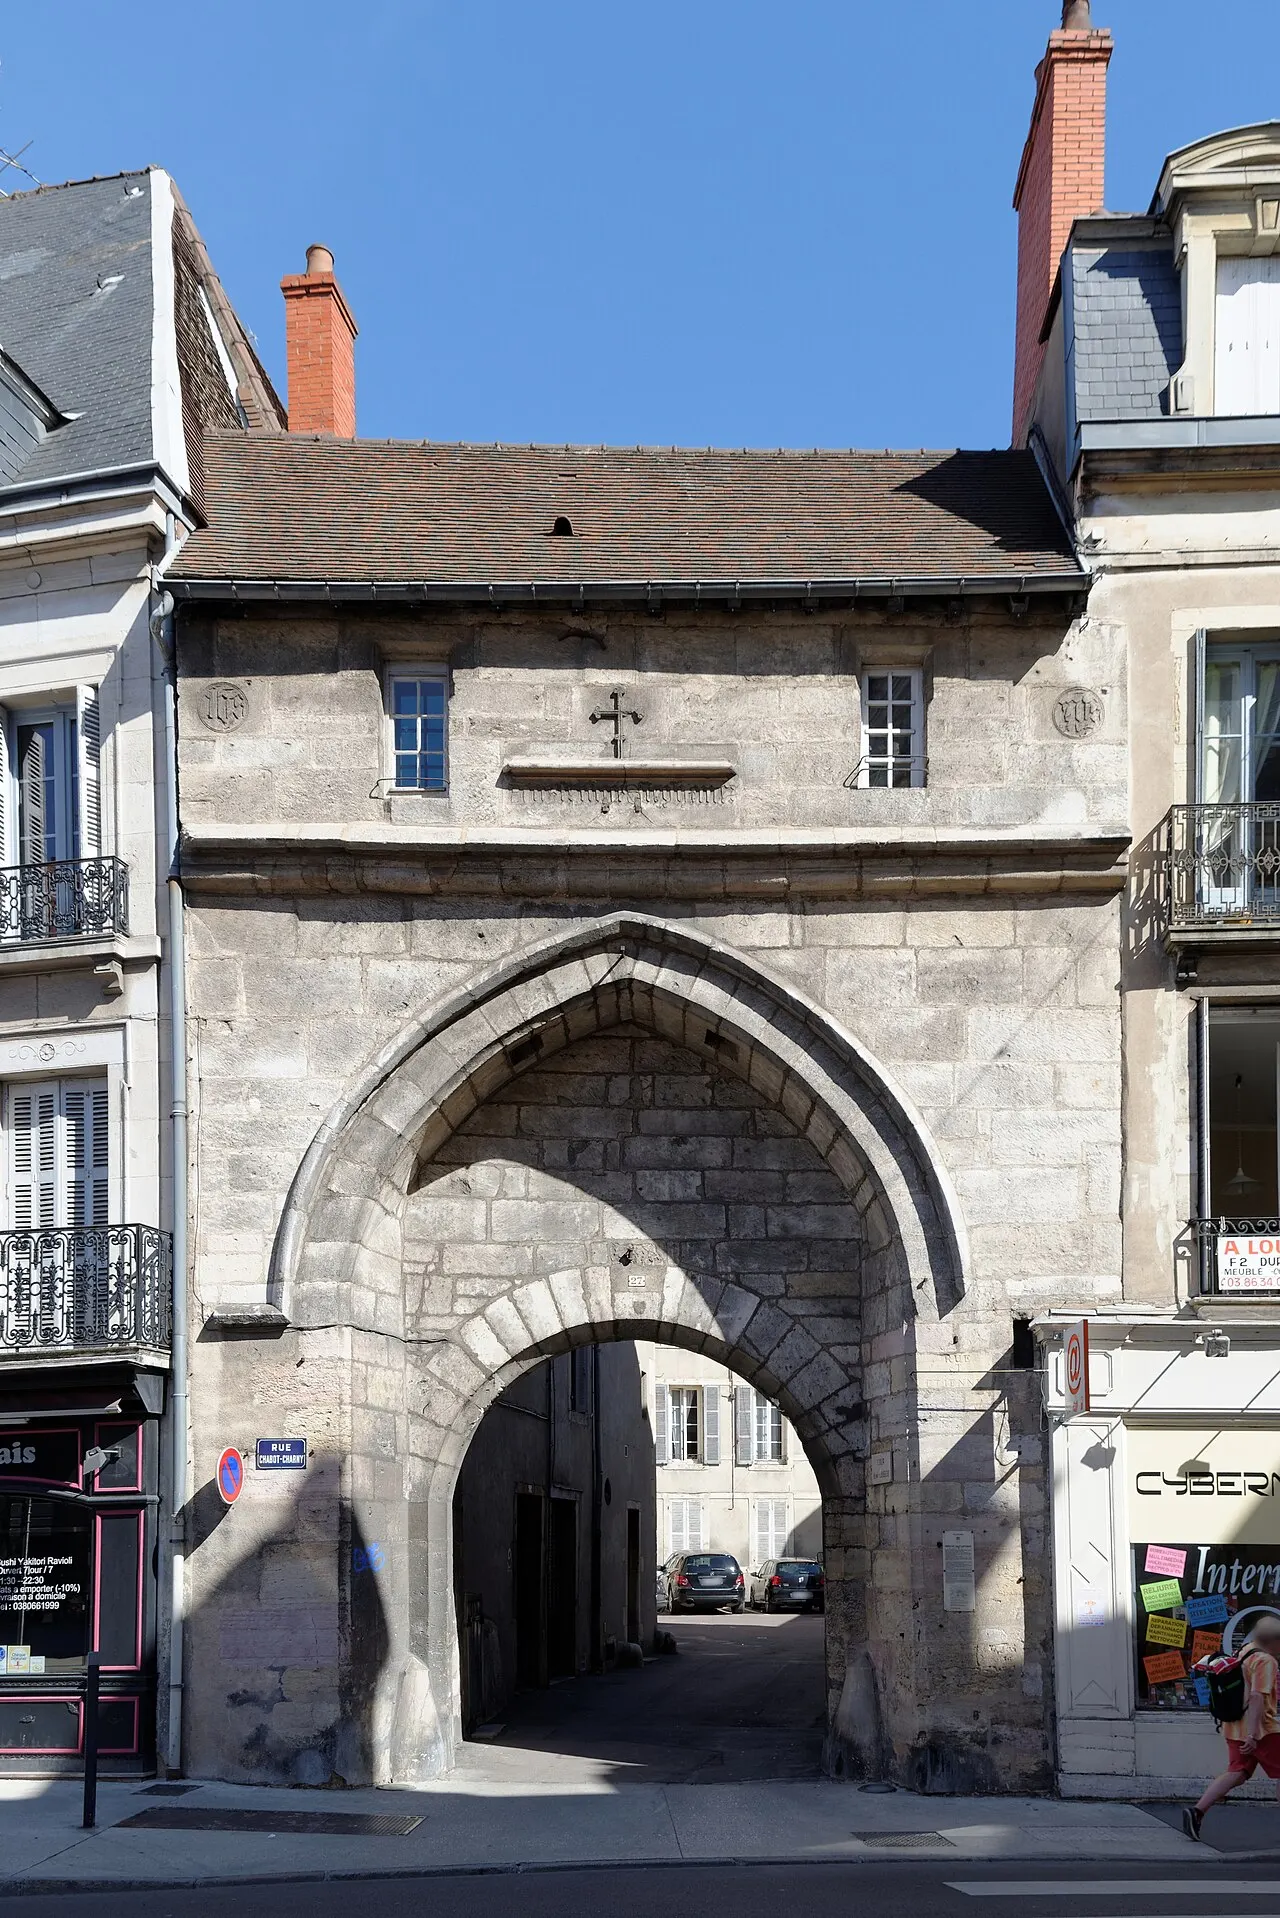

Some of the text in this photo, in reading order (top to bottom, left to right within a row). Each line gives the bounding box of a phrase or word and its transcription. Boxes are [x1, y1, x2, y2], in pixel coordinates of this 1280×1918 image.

[1224, 1240, 1240, 1255] A
[630, 1276, 643, 1285] 27
[944, 1354, 971, 1364] RUE
[925, 1378, 979, 1387] ETIENN
[271, 1443, 292, 1452] RUE
[0, 1441, 36, 1465] ais
[259, 1454, 304, 1464] CHABOT-CHARNY
[18, 1557, 46, 1566] Yakitori
[47, 1556, 73, 1565] Ravioli
[48, 1566, 54, 1574] 7
[20, 1585, 53, 1594] emporter
[54, 1583, 81, 1593] (-10%)
[1143, 1582, 1177, 1595] RELIURES
[35, 1591, 66, 1601] domicile
[13, 1601, 60, 1611] 0380661999
